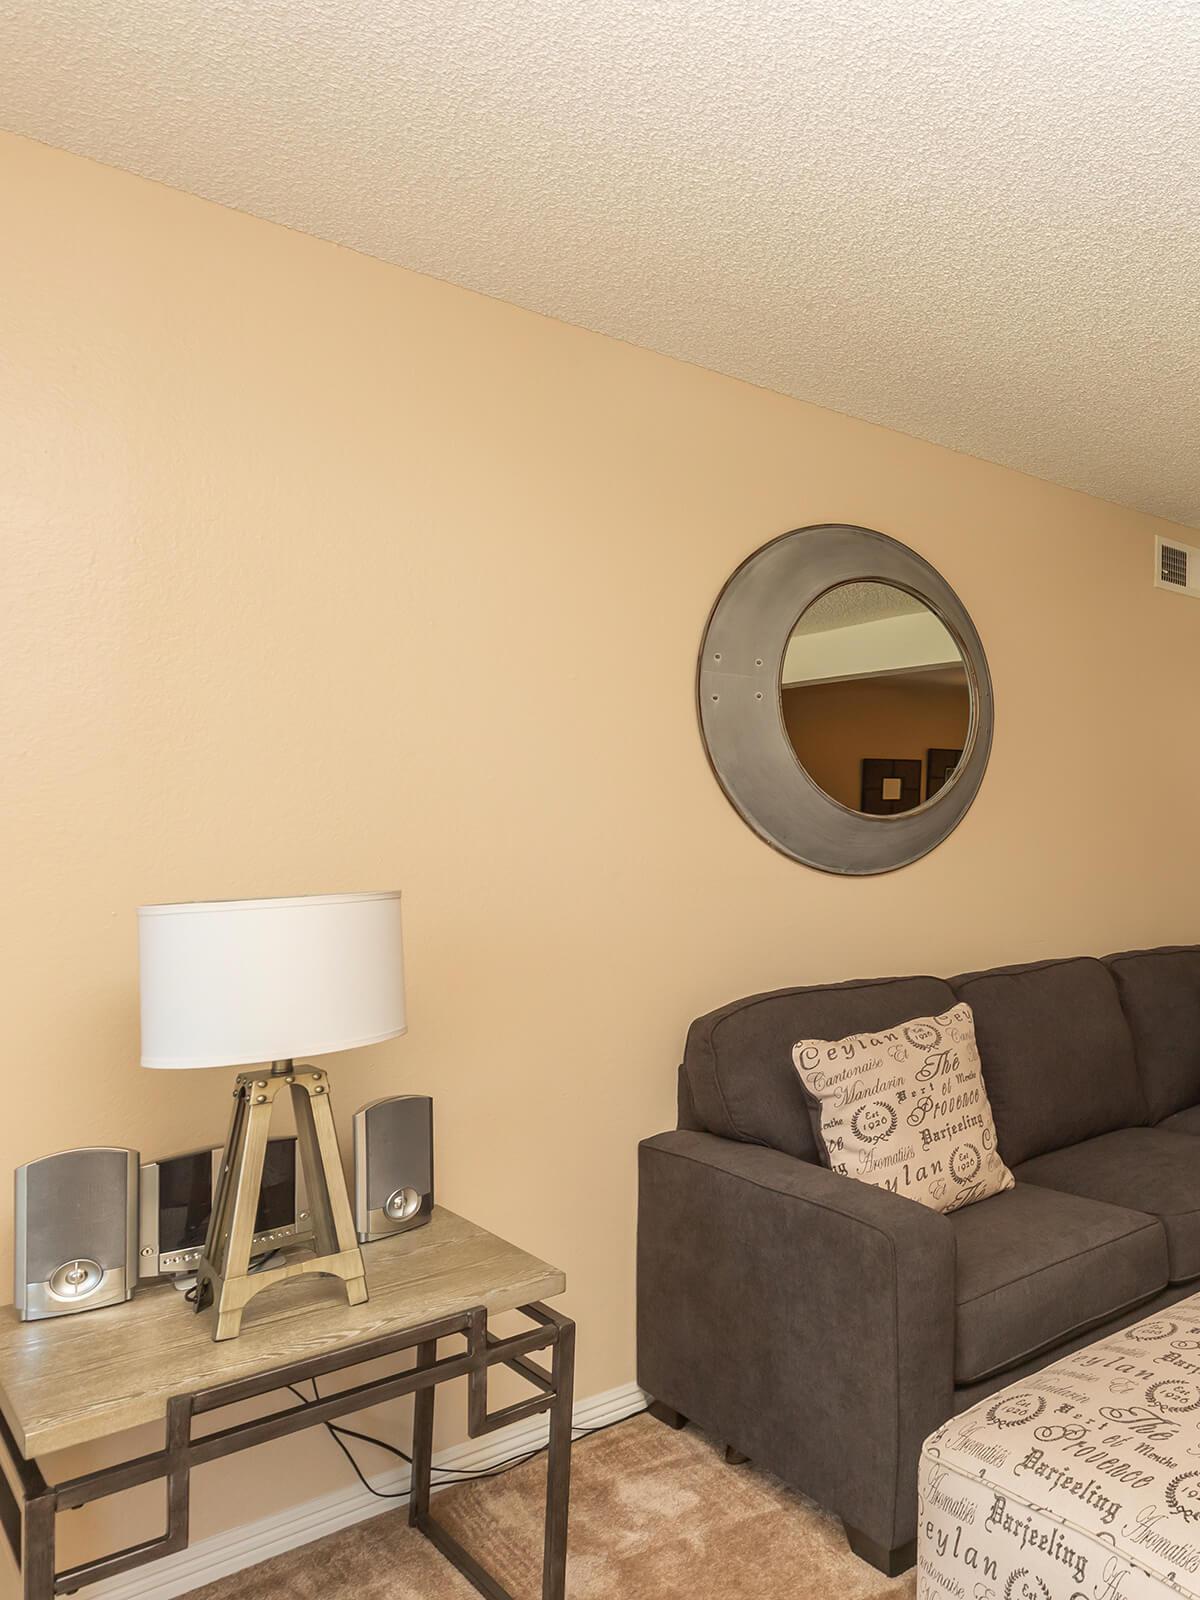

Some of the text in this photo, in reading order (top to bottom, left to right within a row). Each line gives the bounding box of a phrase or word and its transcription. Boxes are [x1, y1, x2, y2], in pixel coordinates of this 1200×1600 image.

[799, 1032, 898, 1070] Ceylan
[915, 1049, 960, 1082] Thé
[807, 1057, 883, 1091] Cantonaise
[833, 1075, 904, 1108] Mandarin
[907, 1089, 979, 1127] Provence
[863, 1116, 887, 1131] 1926
[865, 1111, 879, 1120] Est
[919, 1114, 984, 1151] Darjeeling
[957, 1159, 974, 1171] 1926
[959, 1153, 969, 1161] Est
[928, 1179, 946, 1200] Et
[1014, 1399, 1032, 1408] Est
[1173, 1385, 1190, 1396] Est
[1099, 1406, 1181, 1441] Thé
[1034, 1424, 1155, 1489] Provence
[1102, 1435, 1133, 1447] et
[1134, 1441, 1178, 1470] Menthe
[1014, 1447, 1122, 1525] Darjeeling
[984, 1493, 1089, 1584] Darjeeling
